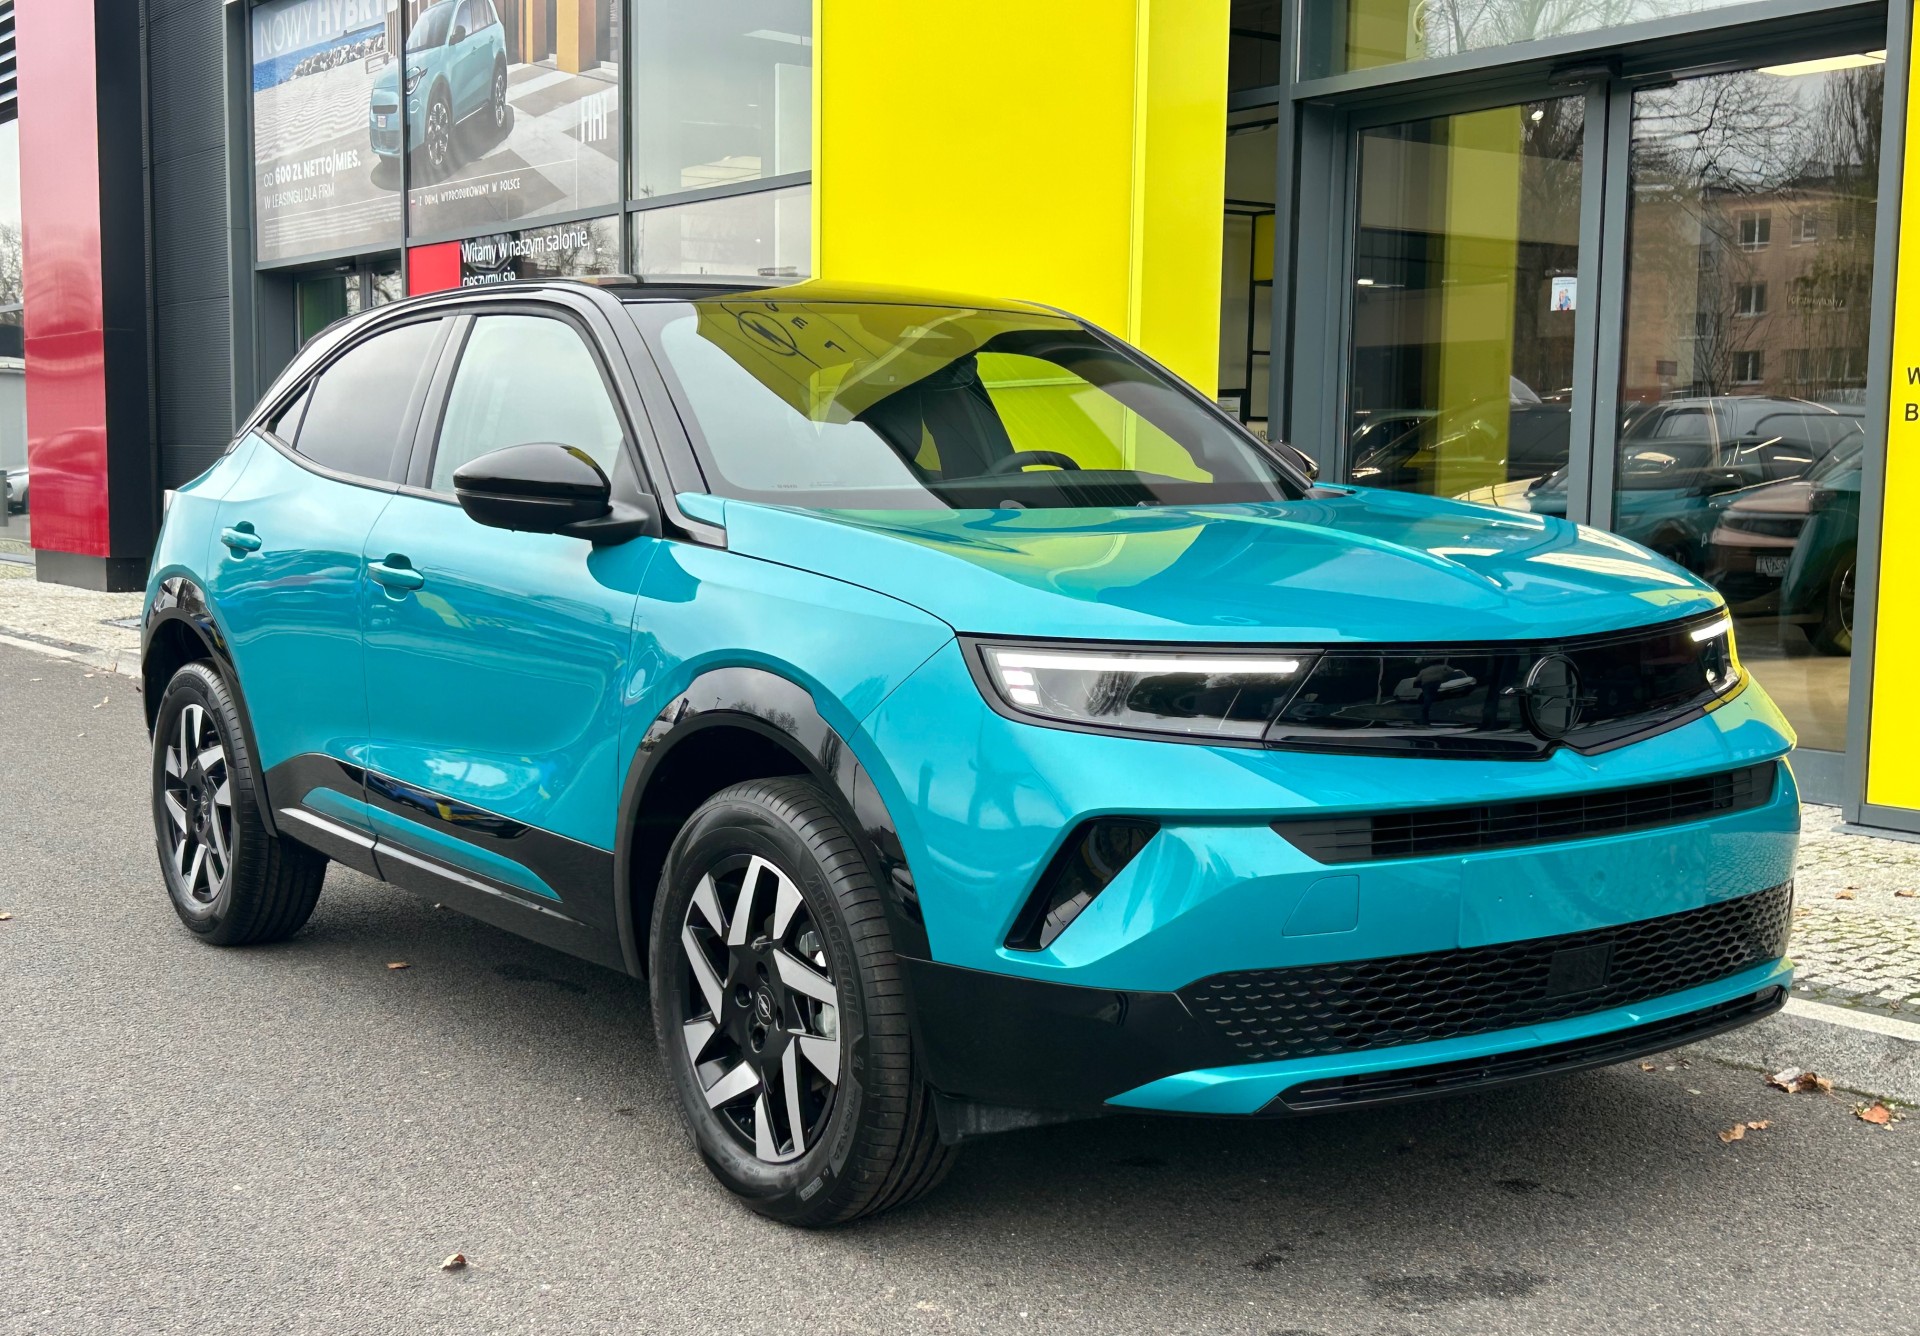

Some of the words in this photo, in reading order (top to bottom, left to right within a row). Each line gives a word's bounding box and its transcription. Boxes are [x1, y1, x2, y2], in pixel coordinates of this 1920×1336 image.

[260, 3, 313, 57] NOWY
[317, 0, 399, 37] HYBR
[581, 94, 608, 144] FIAT
[264, 172, 274, 187] OD
[275, 164, 291, 185] 600
[303, 149, 361, 179] NETTO/MIES.
[492, 181, 498, 193] W
[500, 177, 520, 192] POLSCE
[264, 196, 271, 210] W
[272, 189, 303, 208] LEASINGU
[304, 186, 317, 202] DLA
[319, 182, 335, 200] FIRM
[461, 241, 496, 264] Witamy
[498, 241, 508, 259] w
[509, 234, 544, 259] naszym
[546, 226, 590, 253] salonie,
